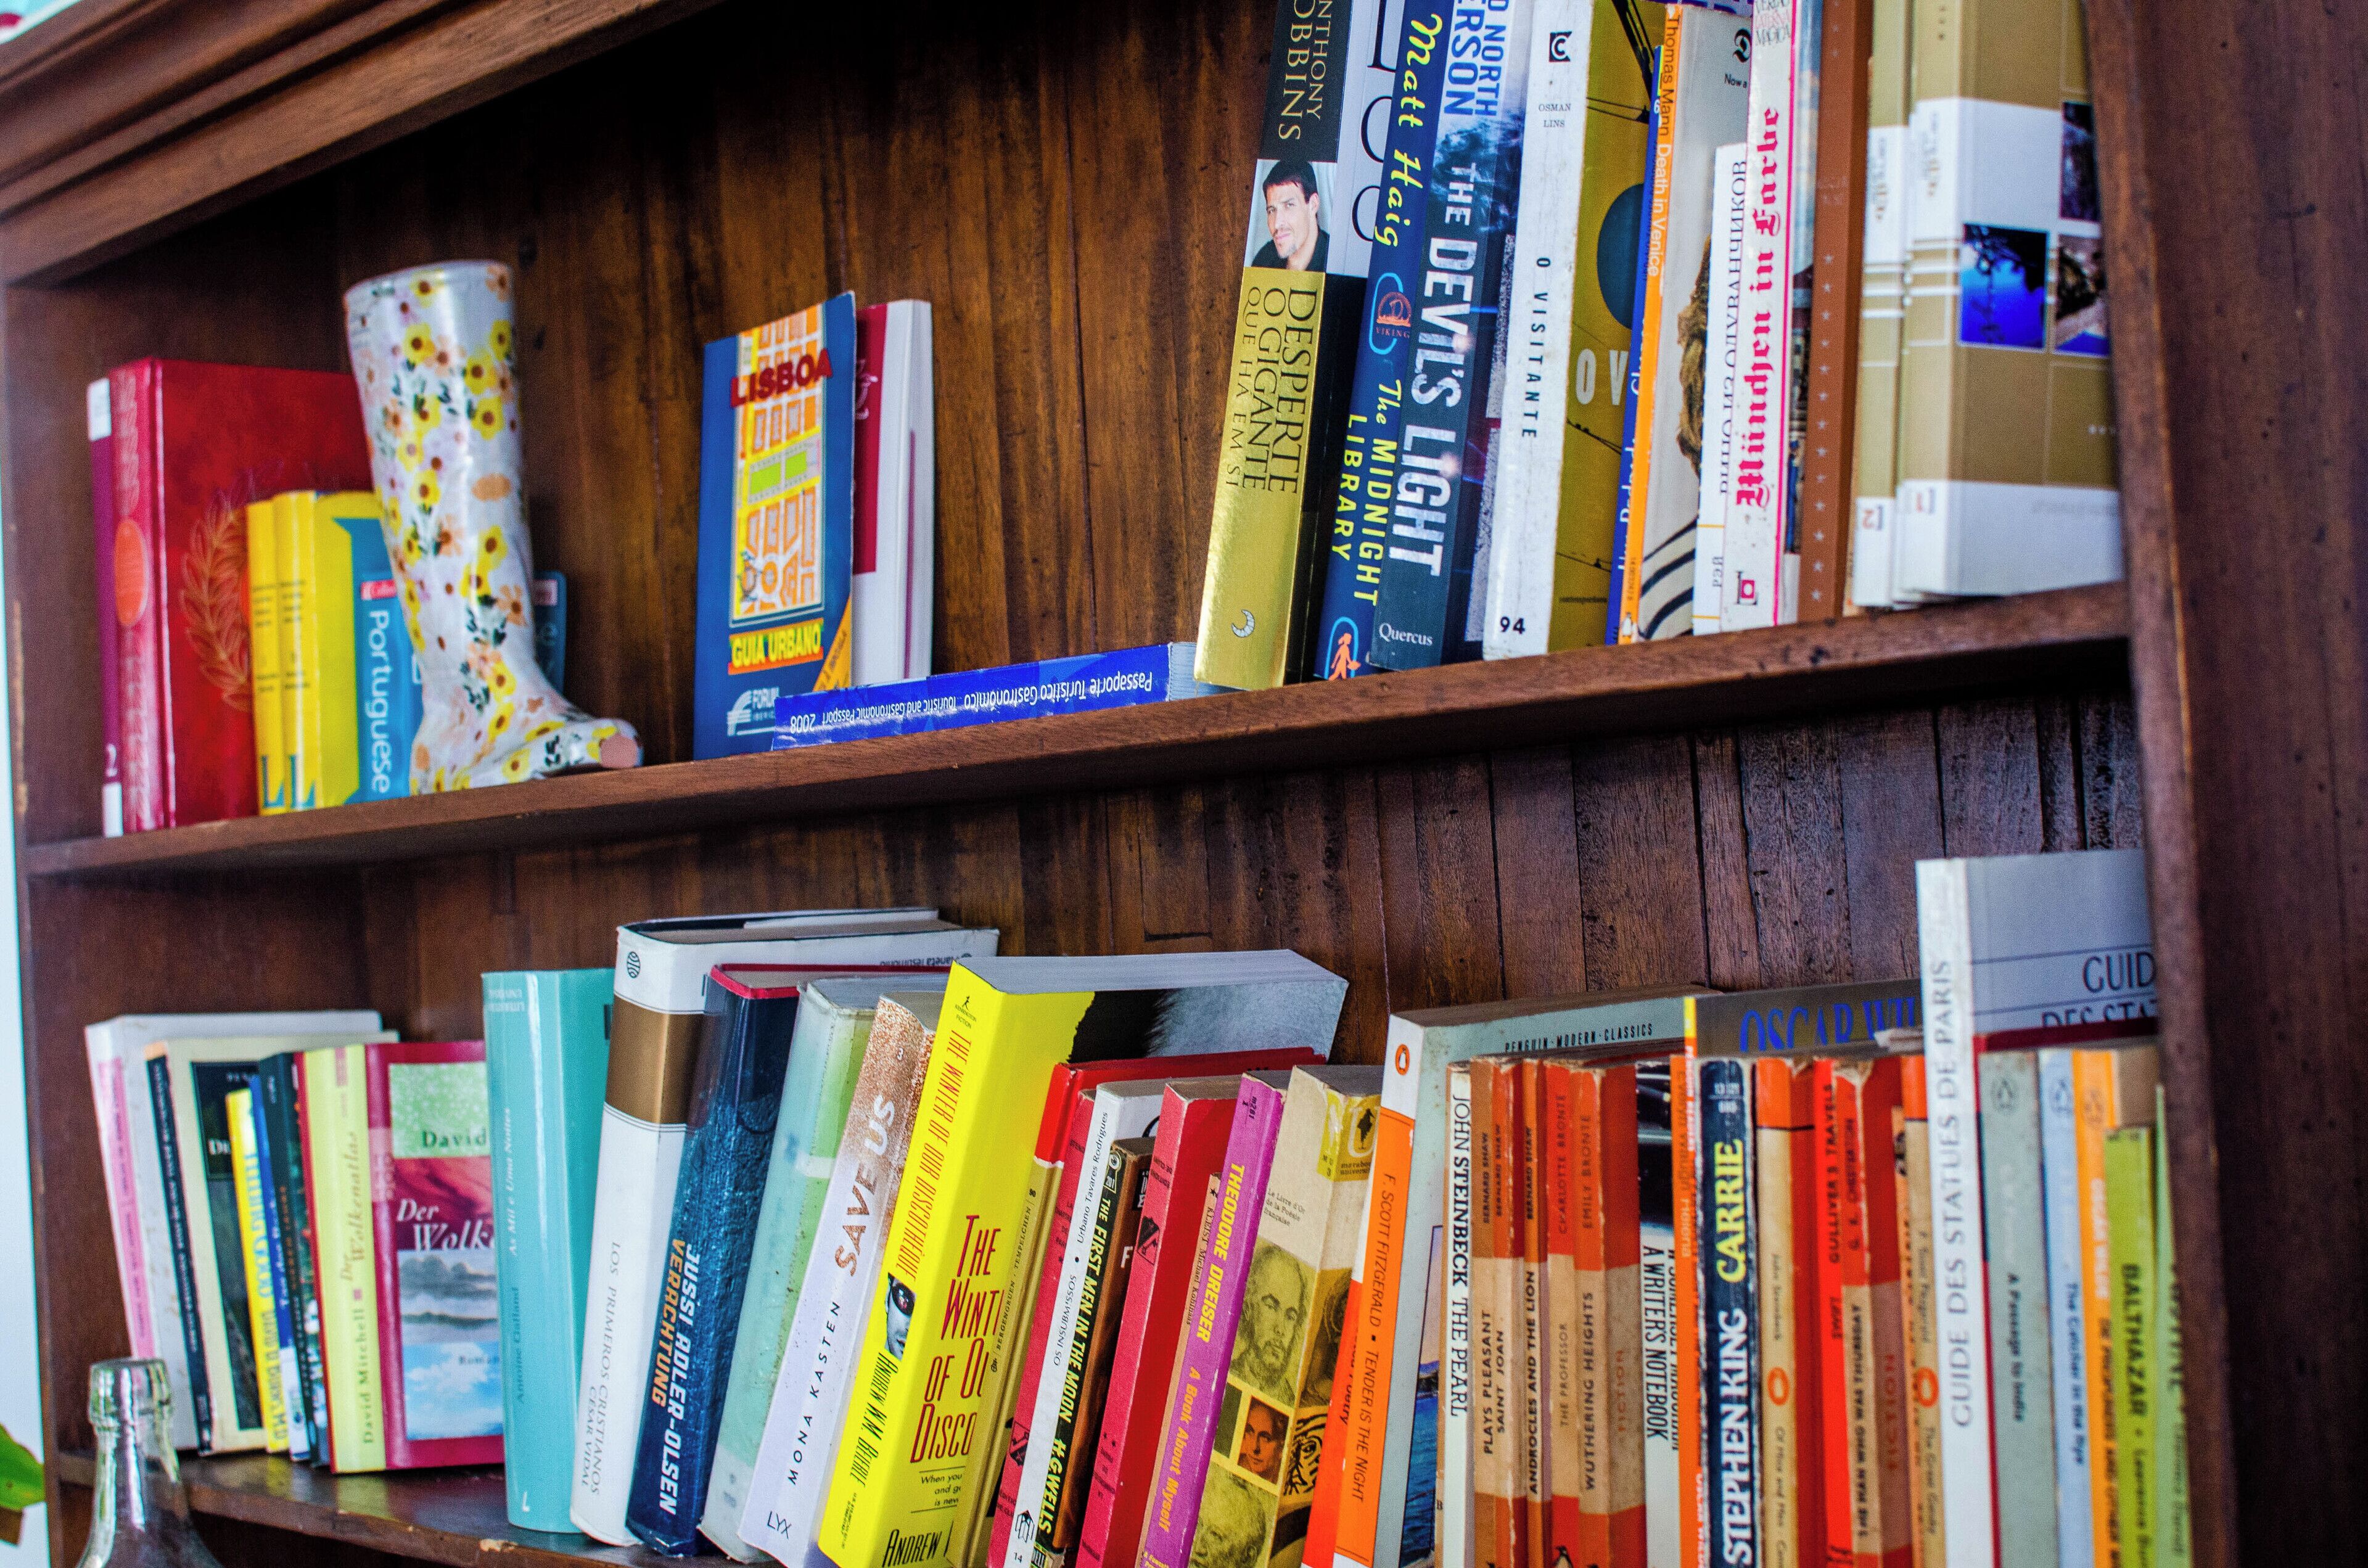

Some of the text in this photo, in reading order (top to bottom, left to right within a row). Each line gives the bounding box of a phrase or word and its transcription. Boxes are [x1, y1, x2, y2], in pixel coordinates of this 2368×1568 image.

[1307, 0, 1332, 120] NTHONY
[1475, 25, 1506, 116] NORTH
[1375, 14, 1443, 247] Matt Haig
[1538, 104, 1571, 112] OSMAN
[1544, 120, 1565, 128] LINS
[1647, 17, 1680, 277] Thomas Mann Death in Venice
[1753, 107, 1781, 237] Farbe
[730, 348, 833, 408] LISBOA
[1229, 286, 1262, 450] QUE HA EM
[1375, 327, 1410, 339] VIKING
[1389, 162, 1478, 577] THE DEVIL'S LIGHT
[1521, 257, 1552, 437] O VISITANTE
[1241, 287, 1286, 491] O GIGANTE
[1267, 287, 1318, 494] DESPERTE
[1331, 413, 1368, 561] LIBRARY
[1353, 379, 1402, 607] The MIDNIGHT
[730, 636, 766, 667] GUIA
[767, 627, 822, 663] URBANO
[1378, 622, 1433, 647] Quercus
[1500, 616, 1525, 636] 94
[365, 608, 391, 794] Portuguese
[789, 713, 815, 734] 2008
[822, 708, 855, 725] Passport
[856, 703, 905, 719] Gastronomic
[906, 700, 921, 713] and
[964, 685, 1038, 710] Gastronómico
[1041, 681, 1086, 702] Turístico
[1090, 671, 1153, 695] Passaporte
[1505, 1023, 1653, 1052] PENGUIN MODERN CLASSICS
[1930, 961, 1954, 1046] PARIS
[923, 1030, 972, 1181] THE WINTER OF OUR
[1937, 1057, 1957, 1100] DE
[421, 1129, 487, 1149] David
[834, 1094, 895, 1277] SAVE US
[1077, 1112, 1109, 1244] Urbano Tavares Rodrigues
[397, 1198, 439, 1221] Der
[956, 1214, 1001, 1277] THE
[1197, 1162, 1245, 1344] THEODORE DREISER
[1582, 1185, 1594, 1230] EMILY
[1714, 1138, 1746, 1283] CARRIE
[1450, 1094, 1470, 1418] JOHN STEINBECK THE PEARL
[1944, 1260, 1968, 1321] DES
[651, 1238, 686, 1408] VERACHTUNG
[996, 1281, 1016, 1351] BERGENGRUEN
[1054, 1350, 1061, 1366] OS
[1059, 1199, 1111, 1423] THE FIRST MEN IN THE MOON
[1352, 1173, 1396, 1503] F. SCOTT FITZGERALD TENDER IS THE NIGHT
[1643, 1246, 1669, 1440] A WRITER'S NOTEBOOK
[2121, 1263, 2148, 1418] BALTHAZAR
[356, 1307, 376, 1445] David Mitchell
[591, 1241, 621, 1496] LOS PRIMEROS CRISTIANOS
[659, 1244, 701, 1516] JUSSI ADLER-OLSEN
[787, 1301, 841, 1486] MONA KASTEN
[871, 1352, 899, 1406] ANDREW
[924, 1354, 955, 1403] OF
[1182, 1382, 1198, 1426] Book
[1191, 1367, 1202, 1379] A
[1481, 1311, 1493, 1455] PLAYS PLEASANT
[1495, 1331, 1505, 1434] SAINT JOAN
[1526, 1271, 1538, 1495] ANDROCLES AND THE LION
[1558, 1323, 1569, 1428] THE PROFESSOR
[1581, 1291, 1596, 1491] WUTHERING HEIGHTS
[1950, 1329, 1973, 1429] GUIDE
[581, 1385, 598, 1487] CESAR VIDAL
[921, 1473, 963, 1486] When you
[1171, 1427, 1190, 1476] About
[1718, 1307, 1752, 1566] STEPHEN KING
[767, 1511, 793, 1540] LYX
[934, 1484, 952, 1495] and
[1157, 1476, 1180, 1532] Myself
[1014, 1552, 1023, 1564] 14
